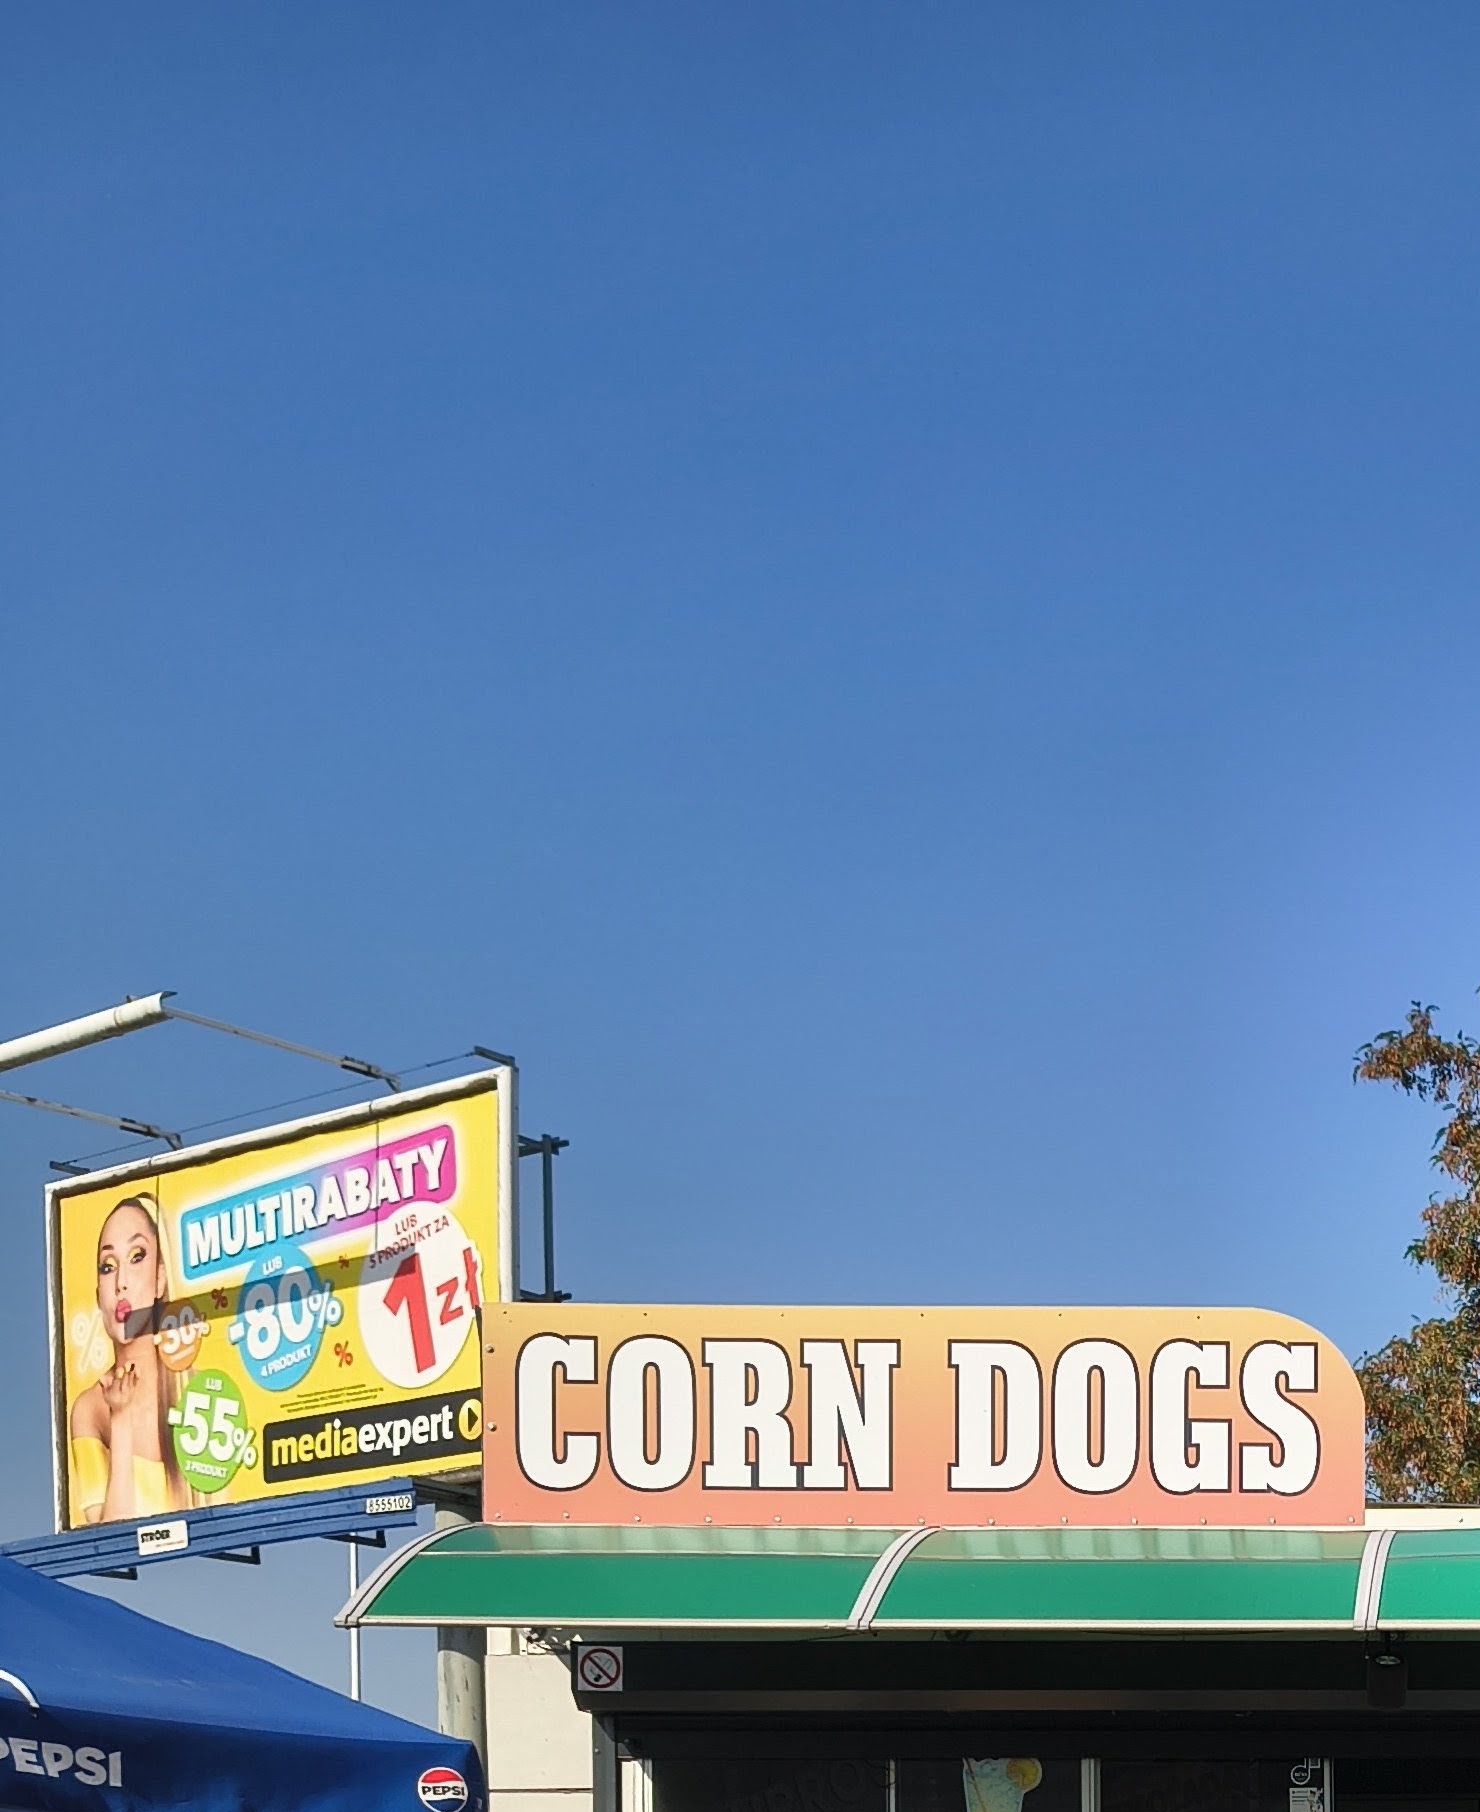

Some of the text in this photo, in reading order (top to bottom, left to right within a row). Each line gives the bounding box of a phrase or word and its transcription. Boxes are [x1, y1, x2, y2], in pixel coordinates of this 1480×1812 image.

[187, 1137, 448, 1268] MULTIRABATY
[395, 1214, 418, 1235] LUB
[263, 1256, 282, 1276] LUB
[378, 1224, 433, 1265] PRODUKT
[433, 1215, 449, 1234] ZA
[228, 1265, 343, 1360] -80%
[383, 1252, 436, 1373] 1
[268, 1344, 312, 1375] PRODUKT
[168, 1391, 258, 1468] -55%
[271, 1404, 454, 1467] mediaexpert
[514, 1332, 1321, 1496] CORN DOGS
[421, 1785, 465, 1796] PEPSI
